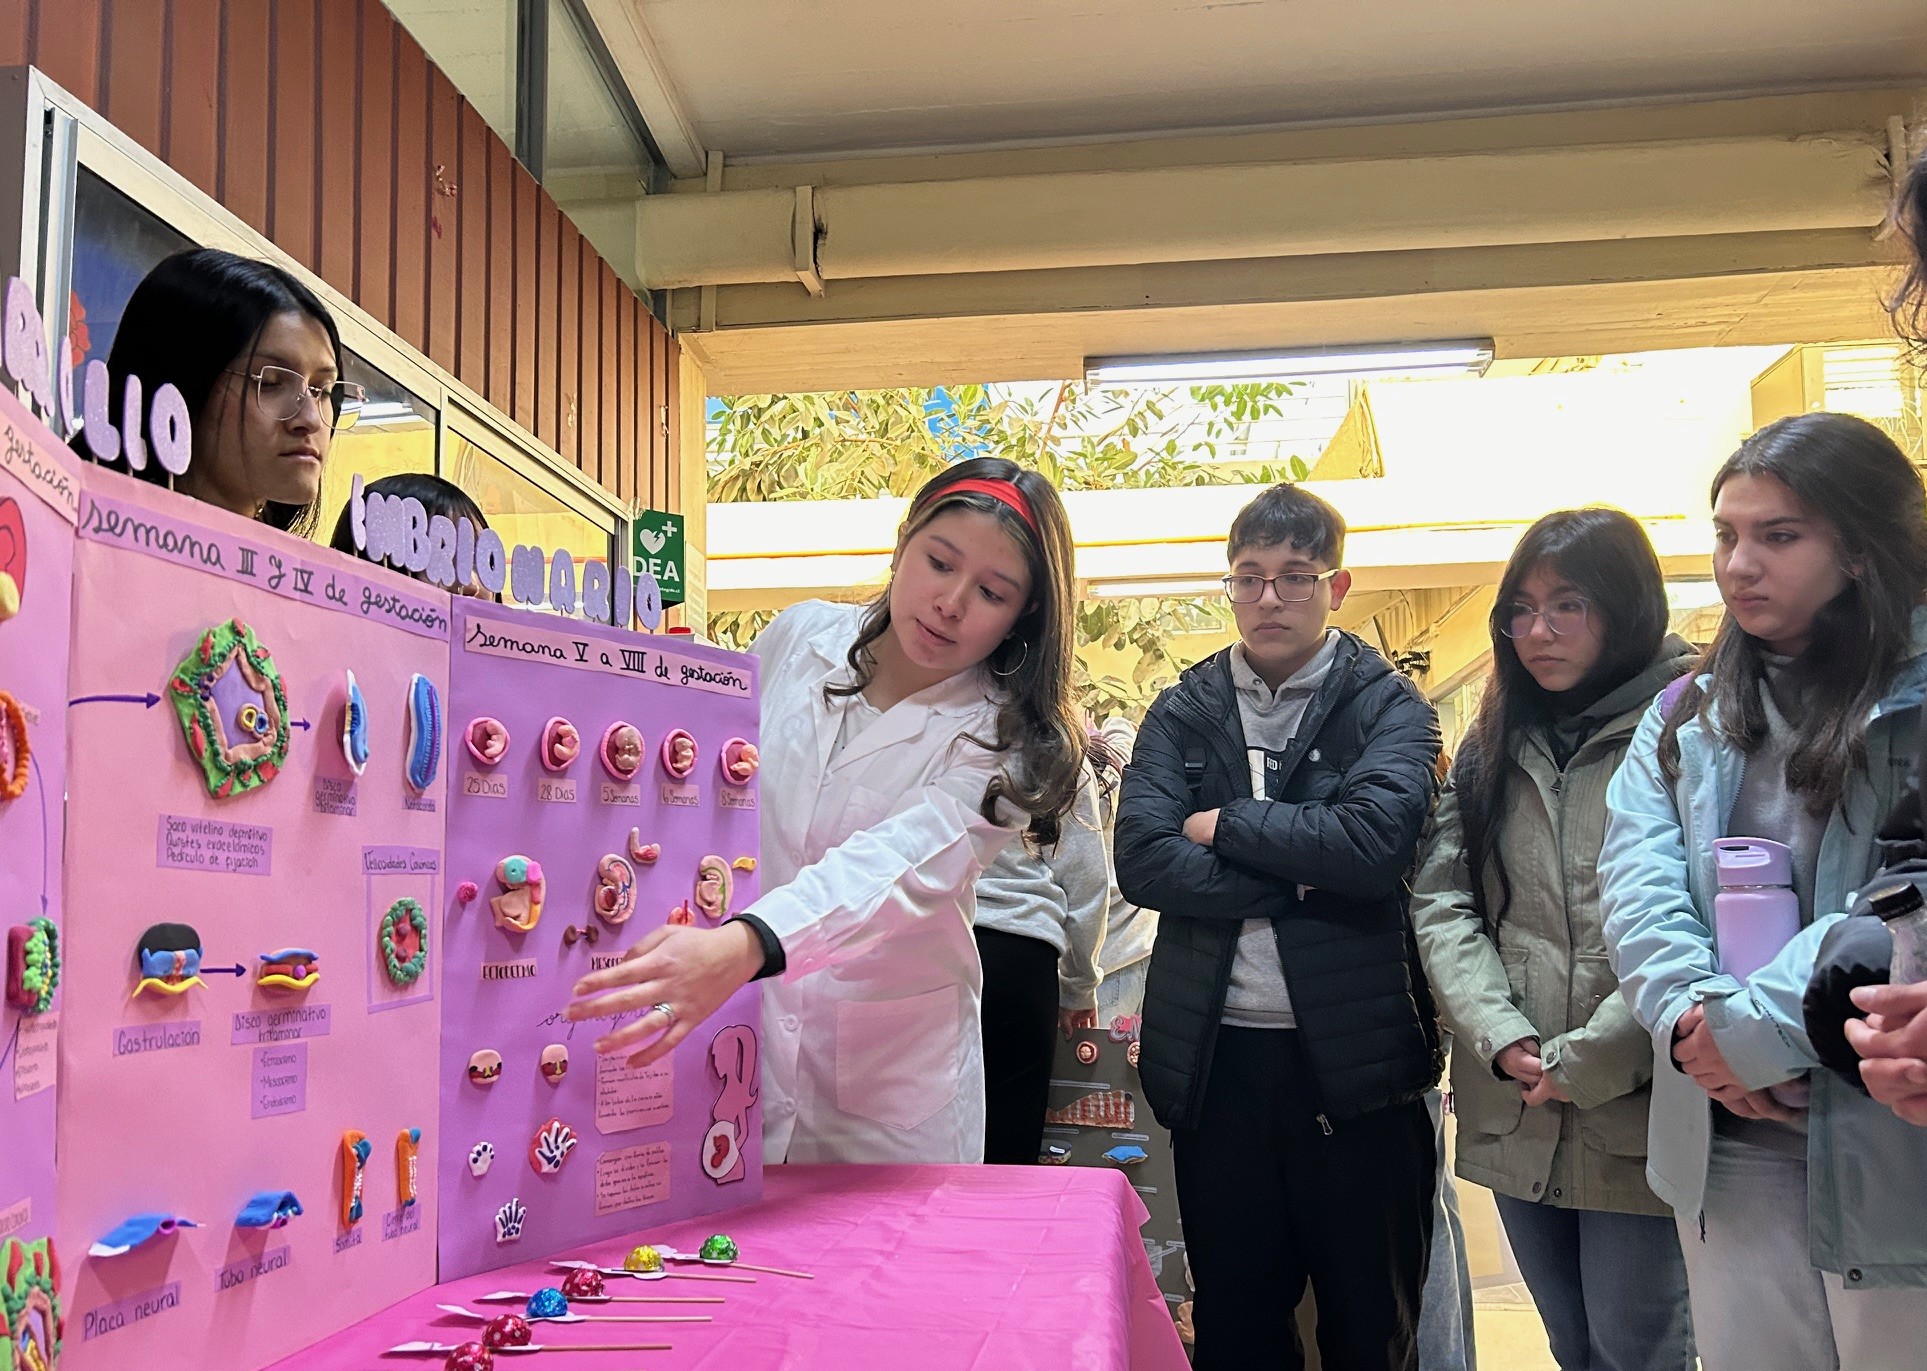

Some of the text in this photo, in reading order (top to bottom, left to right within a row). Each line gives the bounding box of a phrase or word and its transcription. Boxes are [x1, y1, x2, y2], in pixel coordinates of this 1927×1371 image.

[633, 556, 680, 582] DEA
[236, 547, 258, 577] III
[293, 569, 314, 595] IV
[325, 578, 348, 606] de
[360, 585, 447, 633] gestación
[572, 642, 589, 663] V
[600, 652, 613, 668] a
[619, 649, 647, 674] VIII
[654, 655, 669, 680] de
[680, 663, 749, 692] gestación
[467, 776, 480, 793] 25
[540, 784, 552, 800] 28
[602, 786, 639, 804] 5 Semanas
[662, 786, 699, 805] 6 Semanas
[721, 790, 755, 808] 8 Semanas
[166, 831, 201, 849] Quistes
[209, 851, 220, 865] de
[235, 1007, 327, 1031] Disco germinativo
[218, 1248, 288, 1290] Tubo neural
[83, 1284, 181, 1341] Placa neural
